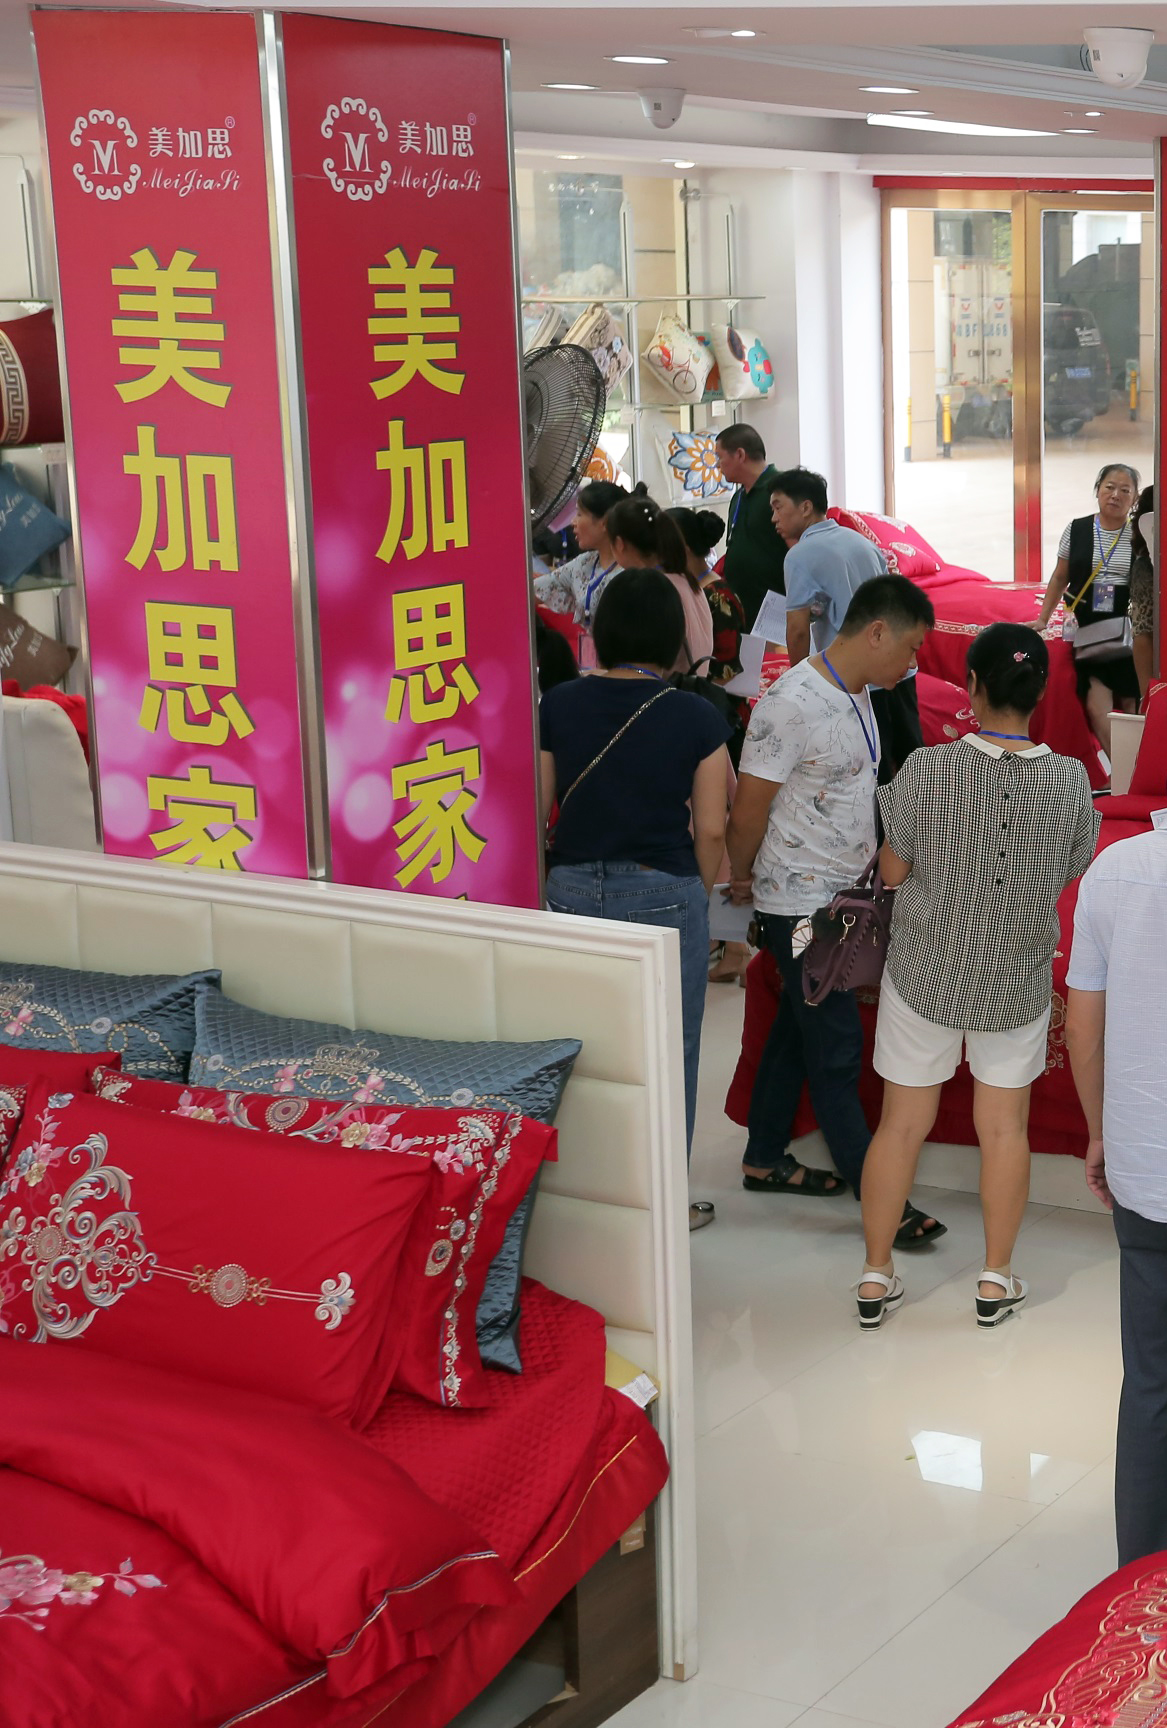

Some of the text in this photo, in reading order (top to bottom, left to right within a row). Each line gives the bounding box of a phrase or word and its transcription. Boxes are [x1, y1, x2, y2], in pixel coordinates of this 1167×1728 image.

[148, 126, 232, 159] 美加思
[398, 120, 475, 158] 美加思
[366, 246, 488, 900] 美加思家
